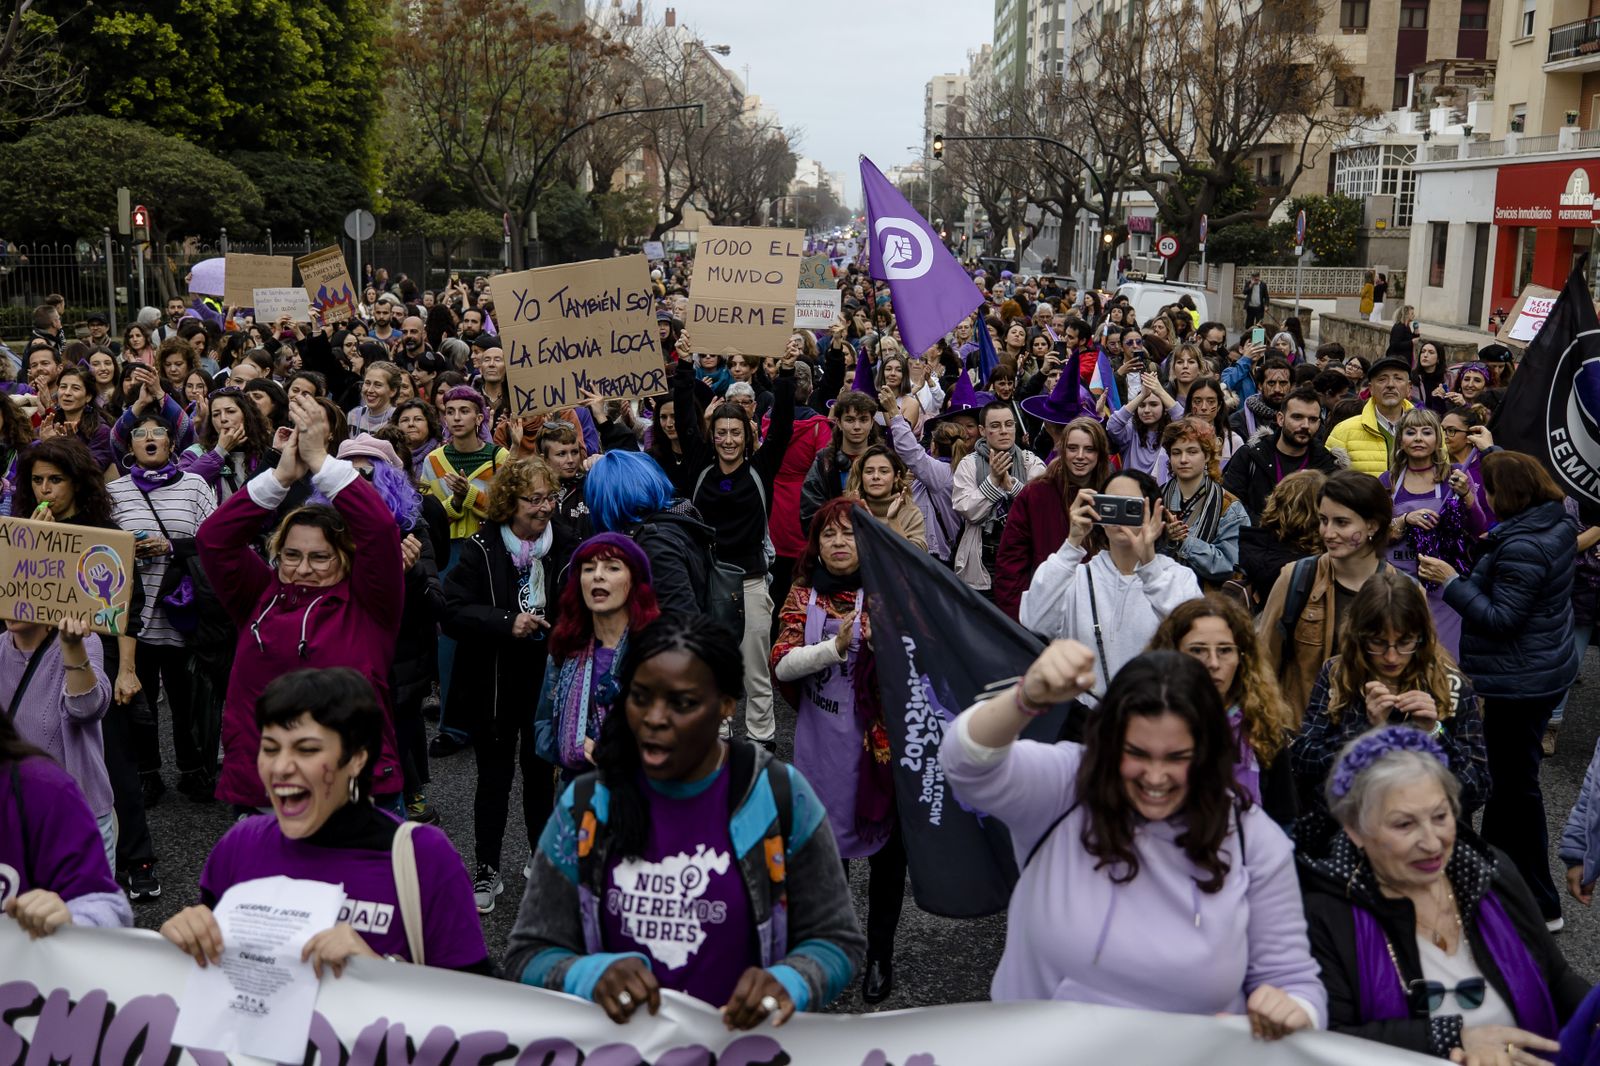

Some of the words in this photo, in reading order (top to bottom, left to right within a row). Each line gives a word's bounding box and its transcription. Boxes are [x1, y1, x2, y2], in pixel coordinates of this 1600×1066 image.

[1495, 205, 1518, 219] Servicios
[1518, 205, 1552, 219] Inmobiliarios
[1558, 209, 1593, 220] PUERTATIERRA
[702, 239, 752, 256] TODO
[769, 240, 800, 257] EL
[1162, 242, 1174, 250] 50
[708, 266, 784, 285] MUNDO
[512, 288, 541, 321] YO
[625, 289, 654, 316] SOY
[693, 303, 788, 326] DUERME
[509, 340, 533, 368] LA
[610, 329, 655, 355] LOCA
[513, 385, 538, 416] DE
[543, 377, 566, 408] UN
[13, 558, 66, 580] MUJER
[634, 873, 676, 895] NOS
[606, 888, 727, 924] QUEREMOS
[621, 917, 700, 943] LIBRES
